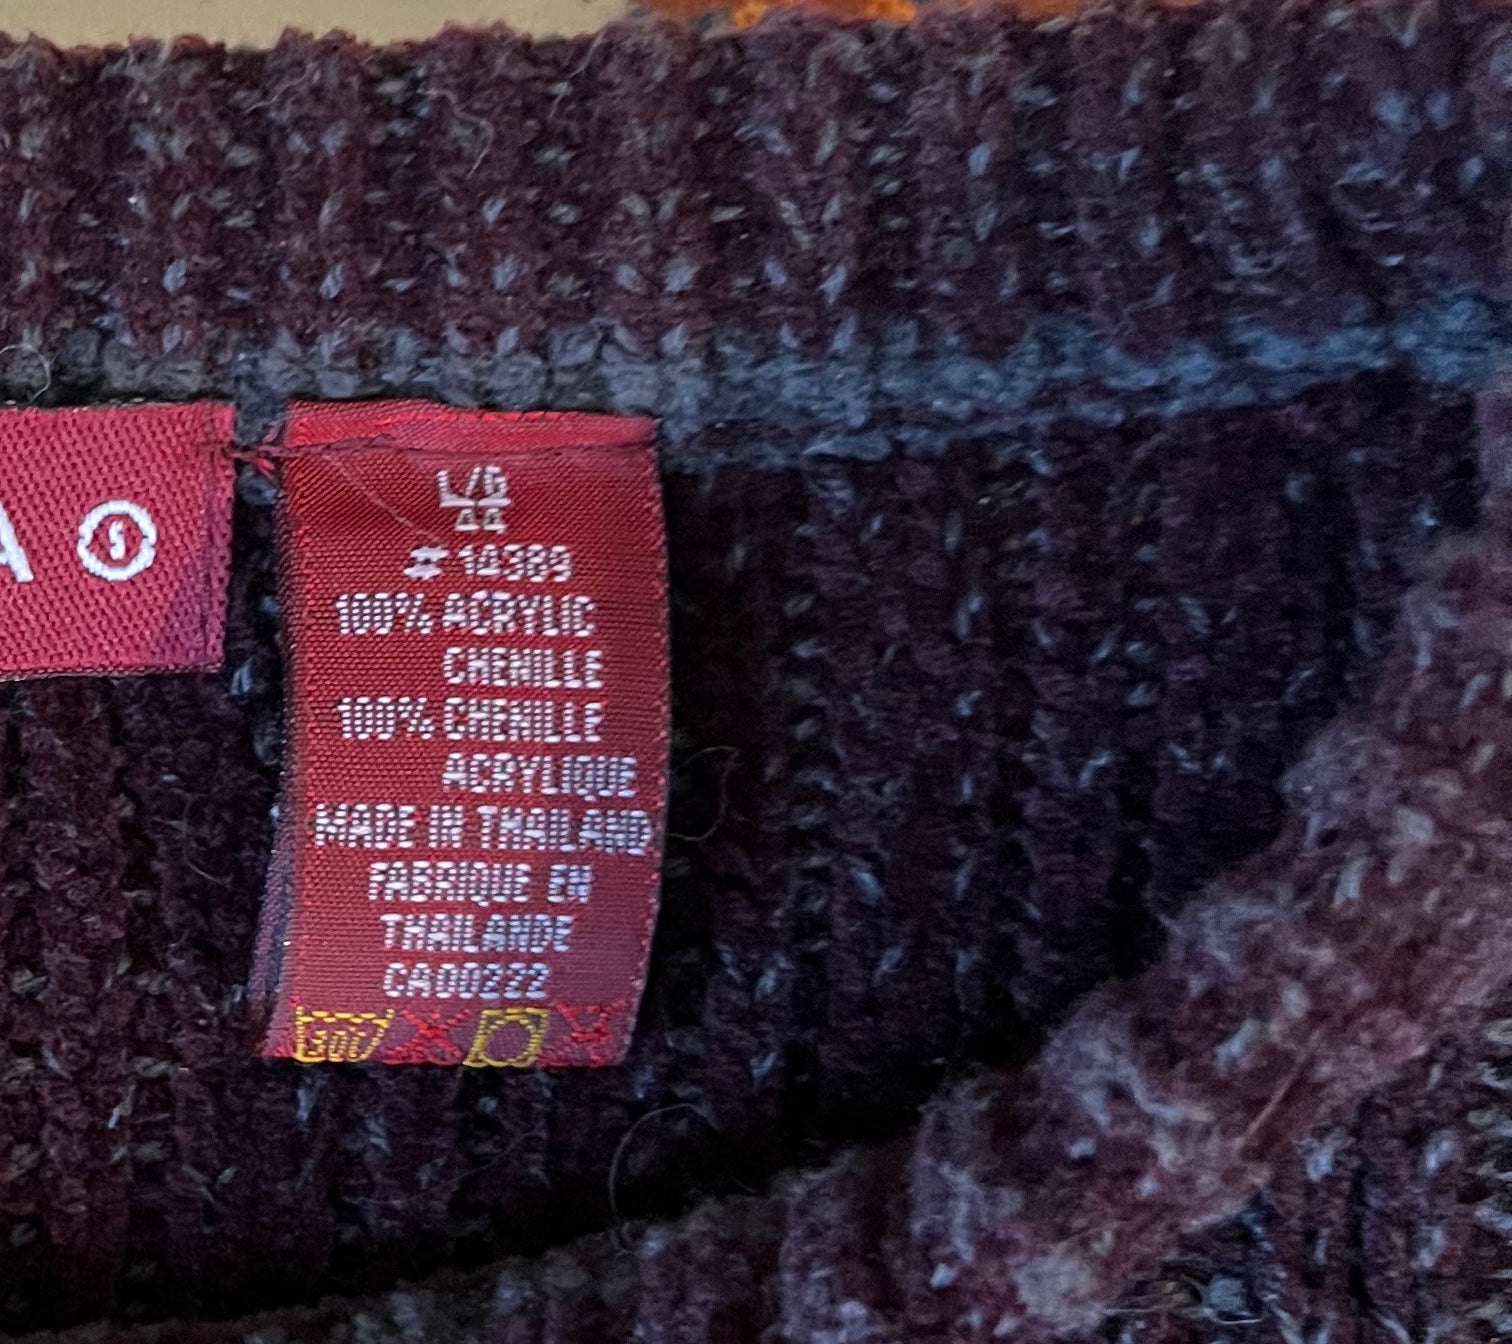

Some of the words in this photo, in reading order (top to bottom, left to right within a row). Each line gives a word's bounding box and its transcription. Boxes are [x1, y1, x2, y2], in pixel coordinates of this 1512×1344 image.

[335, 592, 434, 635] 100%
[442, 590, 596, 636] ACRYLIC
[442, 646, 604, 689] CHENILLE
[336, 697, 435, 740] 100%
[443, 698, 603, 742] CHENILLE
[442, 753, 638, 802] ACRYLIQUE
[314, 803, 416, 849] MADE
[428, 805, 464, 849] IN
[477, 805, 653, 856] THAILAND
[368, 861, 531, 907] FABRIQUE
[547, 864, 592, 904] EN
[380, 913, 575, 954] THAILANDE
